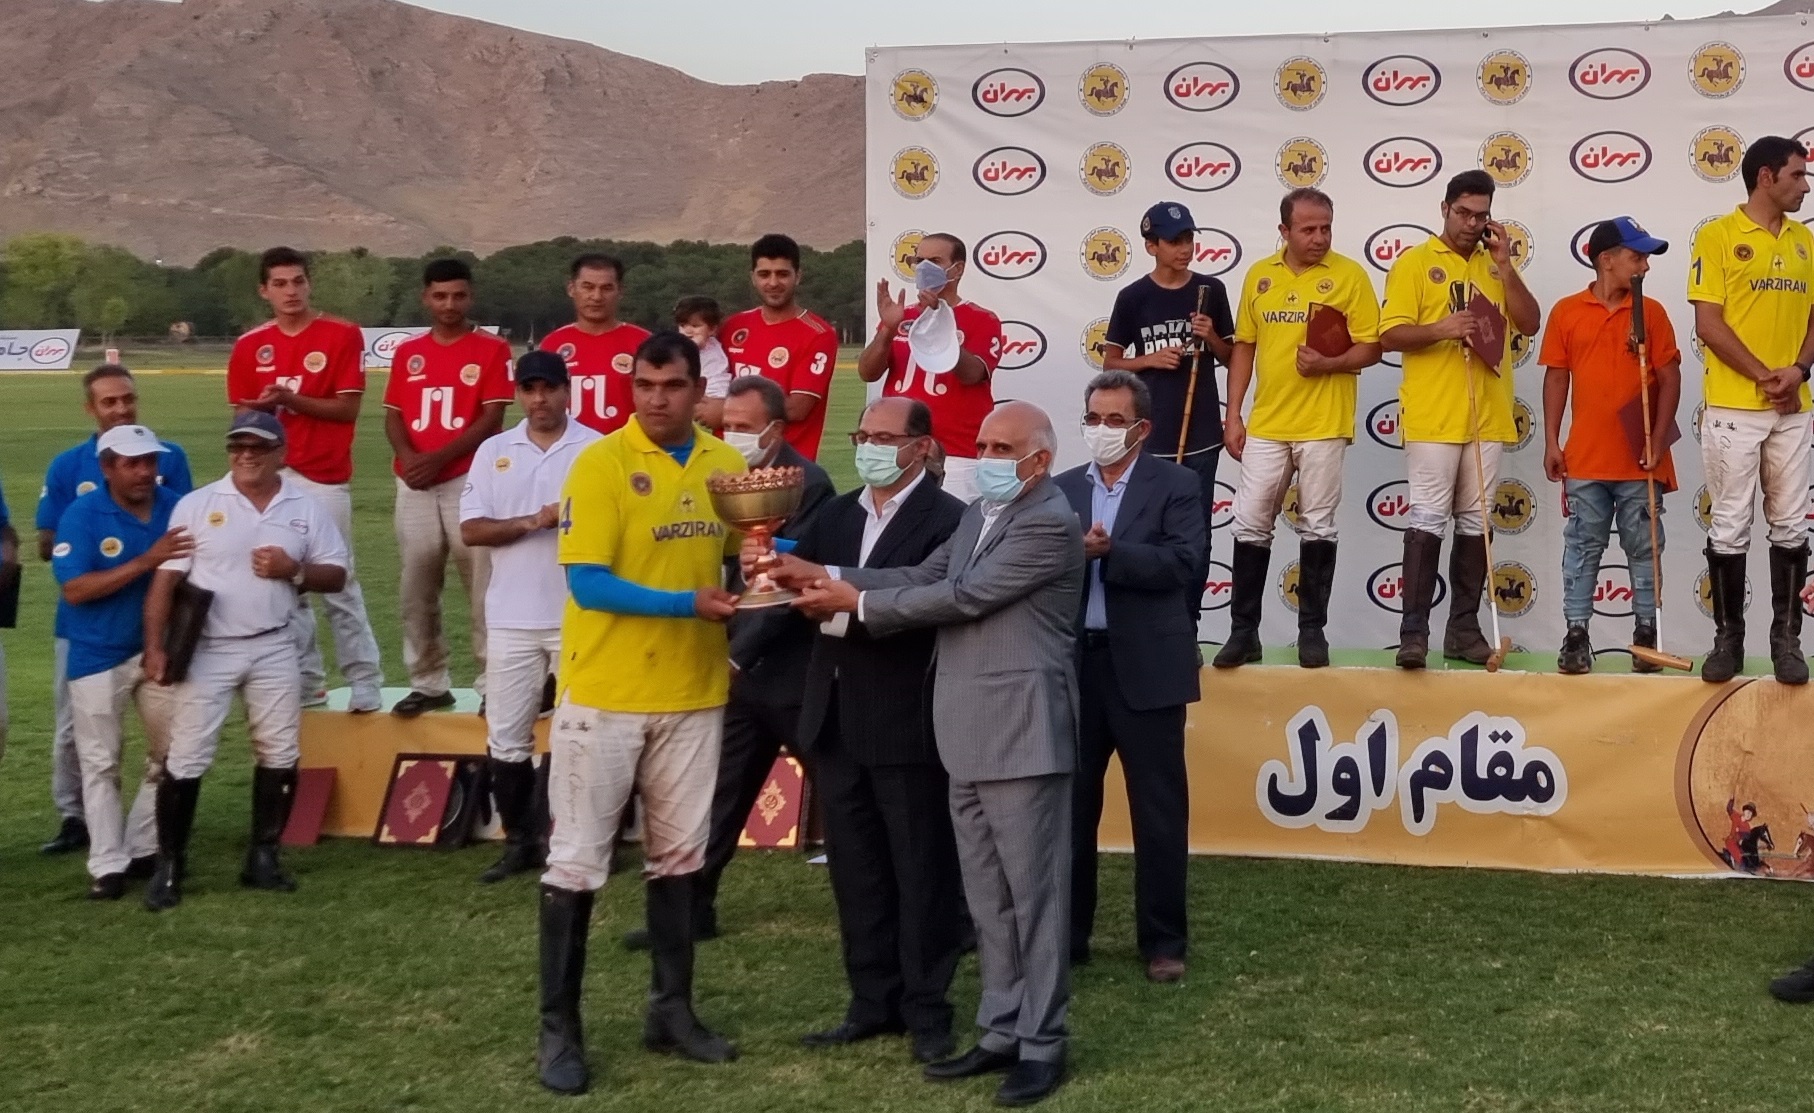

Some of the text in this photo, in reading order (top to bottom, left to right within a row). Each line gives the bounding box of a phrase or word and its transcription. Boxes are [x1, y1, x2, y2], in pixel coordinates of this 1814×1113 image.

[1749, 277, 1807, 294] VARZIRAN
[1262, 311, 1309, 324] VARZIR
[809, 351, 828, 376] 3
[560, 496, 573, 535] 4
[1267, 718, 1556, 824] مقام اول
